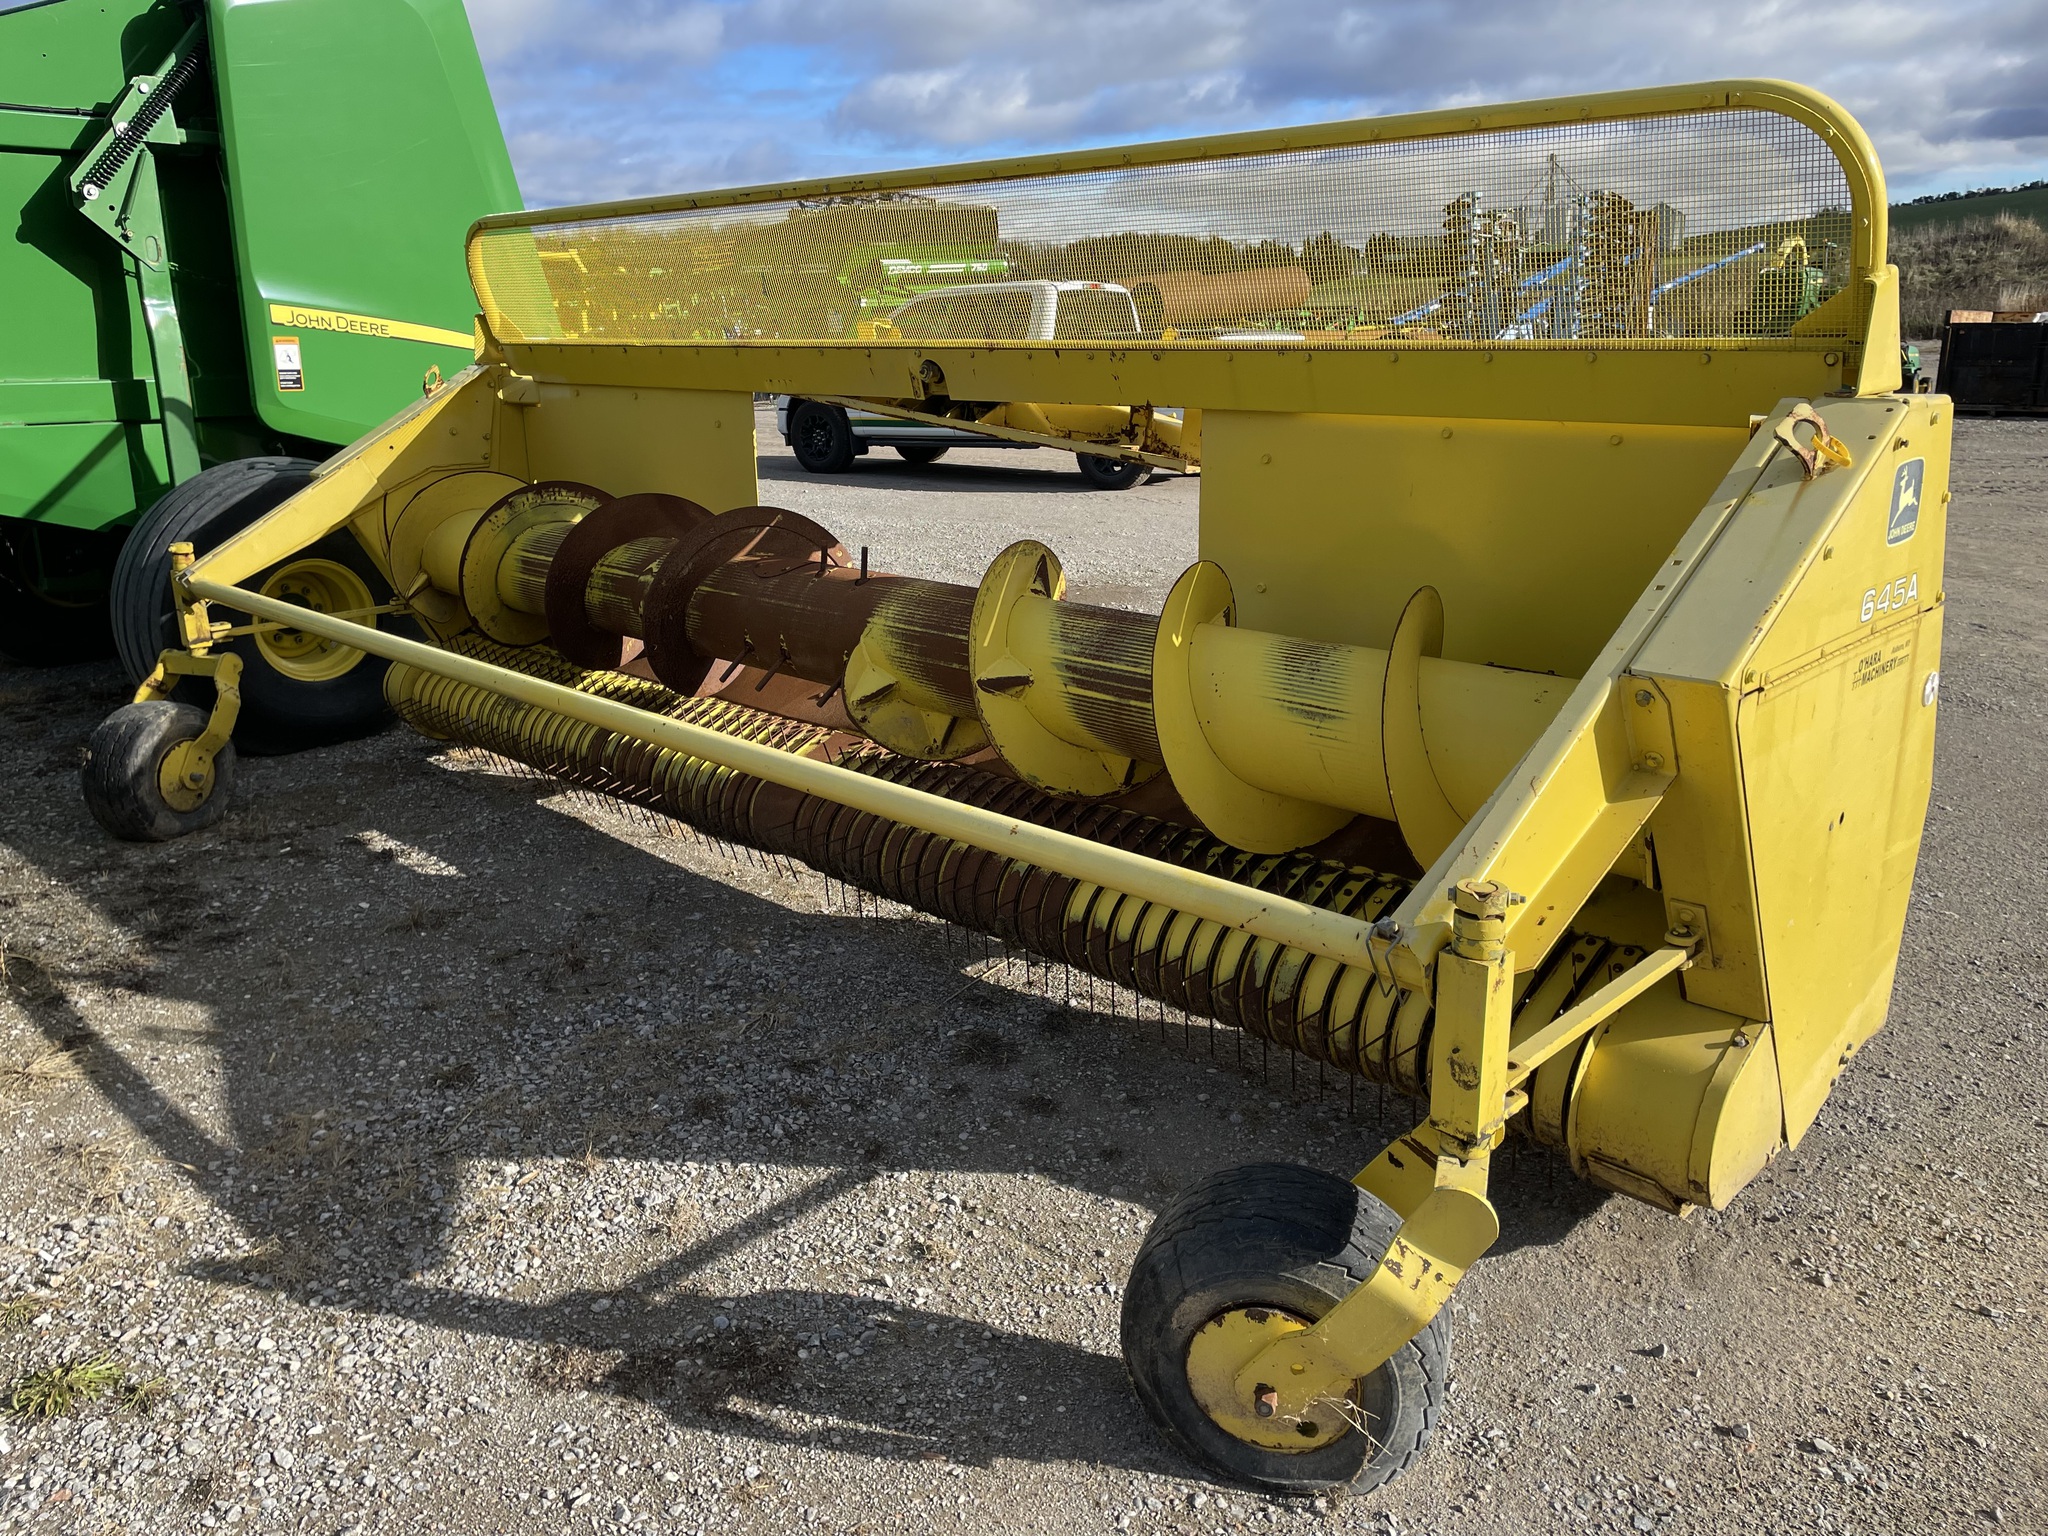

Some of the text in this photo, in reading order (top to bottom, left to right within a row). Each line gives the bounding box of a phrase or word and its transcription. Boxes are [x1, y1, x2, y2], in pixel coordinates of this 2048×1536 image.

[286, 310, 390, 336] JOHN DEERE
[1860, 572, 1918, 623] 645A
[1858, 650, 1882, 673] O'HARA
[1861, 656, 1899, 686] MACHINERY
